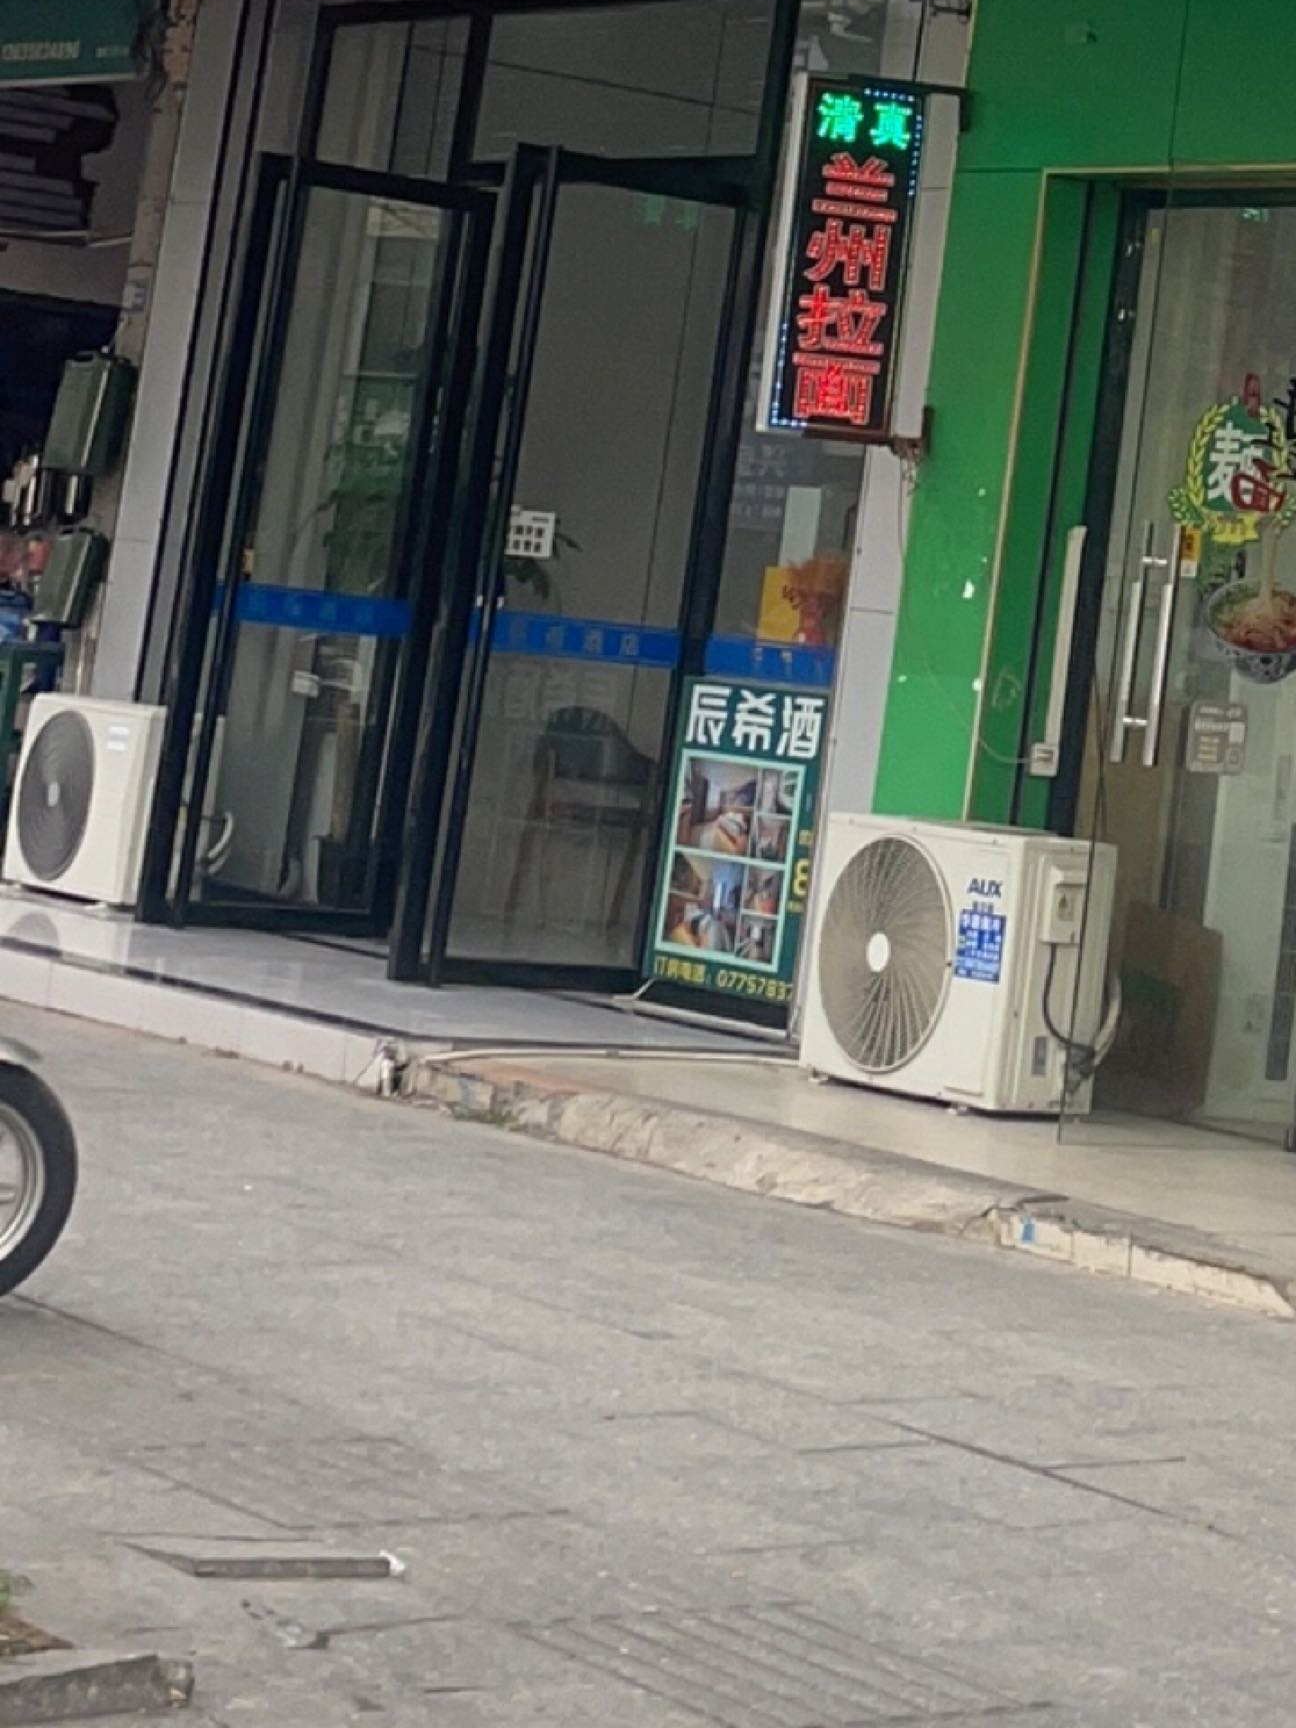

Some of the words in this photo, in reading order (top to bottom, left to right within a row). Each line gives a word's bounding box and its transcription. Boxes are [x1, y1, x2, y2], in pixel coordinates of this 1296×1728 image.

[815, 92, 915, 150] 清真
[791, 151, 899, 425] 兰州拉面
[685, 682, 825, 759] 辰希酒
[967, 877, 1002, 899] AUX
